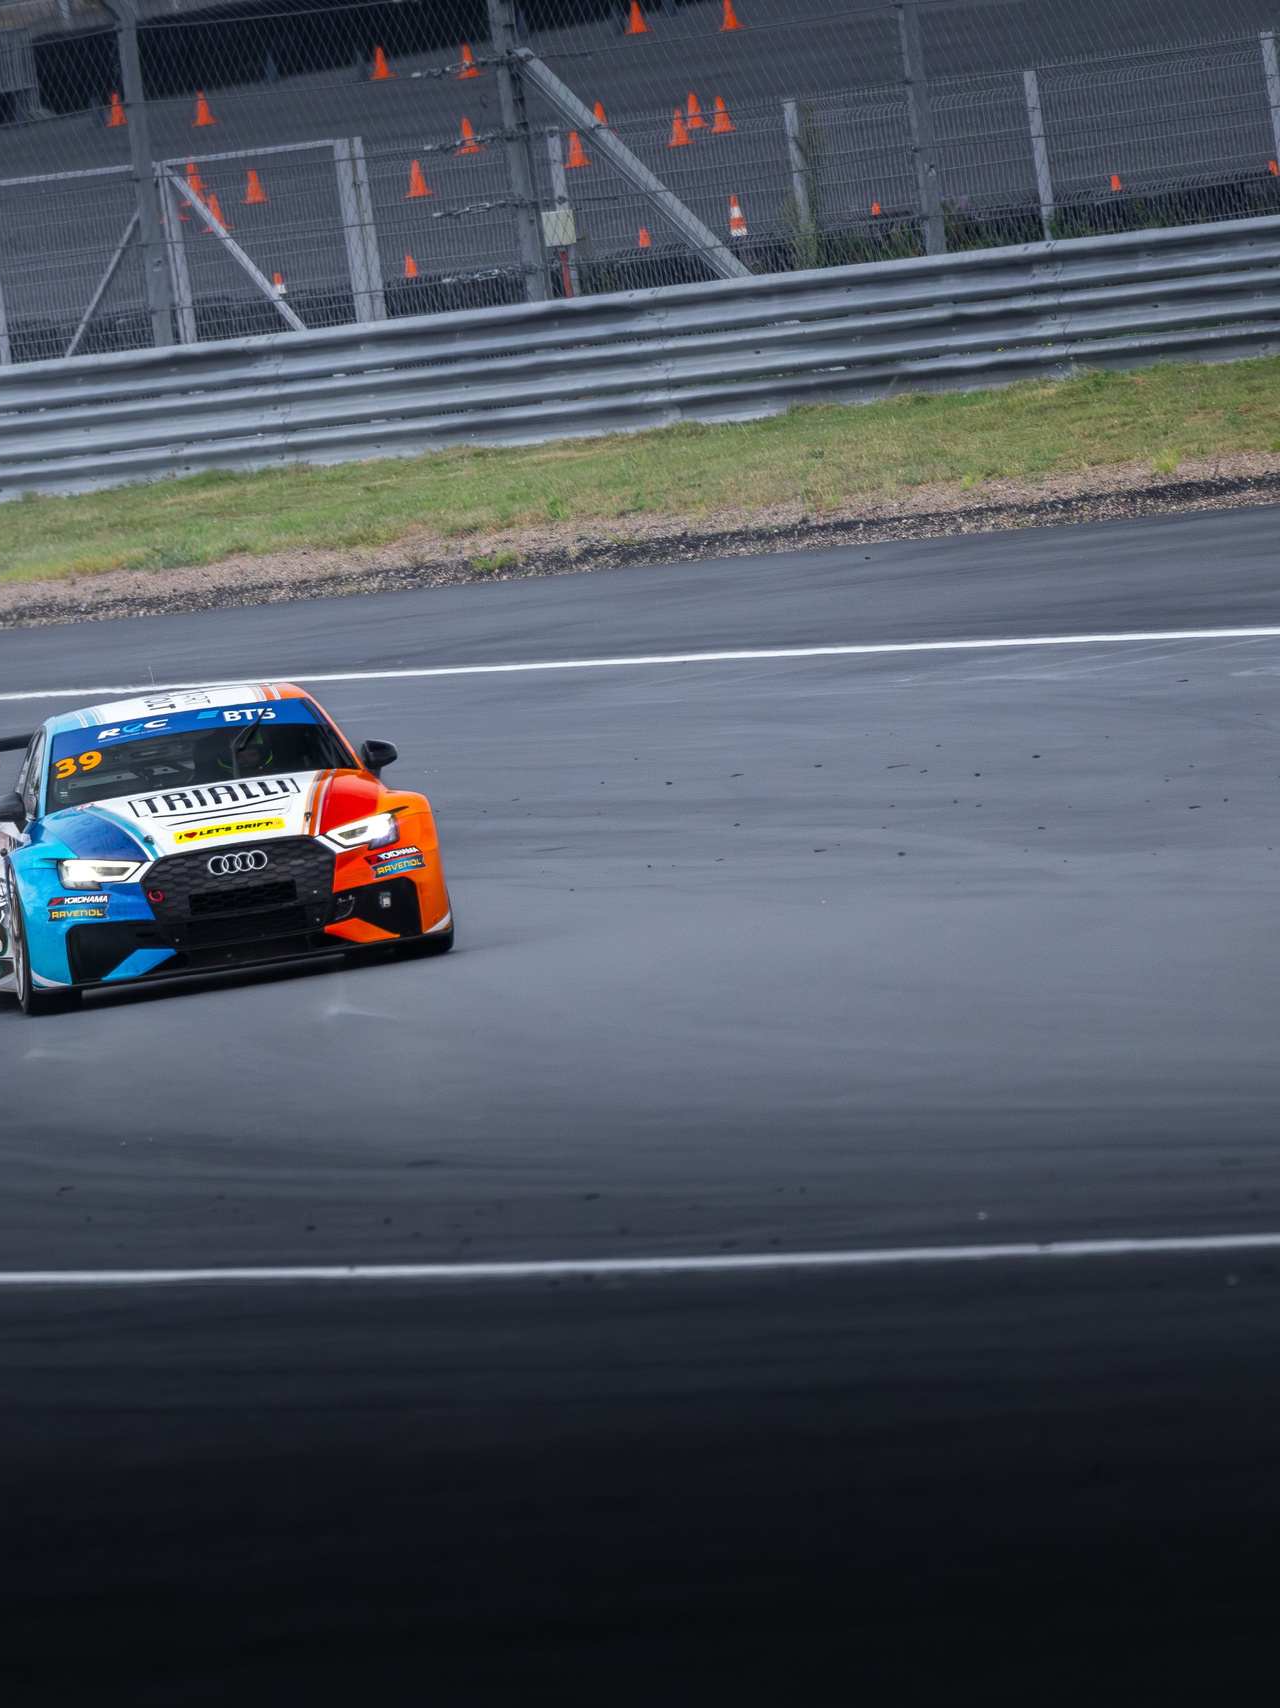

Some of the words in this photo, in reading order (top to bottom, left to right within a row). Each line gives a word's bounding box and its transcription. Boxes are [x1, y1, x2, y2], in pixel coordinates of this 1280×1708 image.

[55, 750, 102, 779] 39
[138, 780, 291, 814] TRIALLI
[199, 826, 232, 836] LET'S
[235, 821, 273, 830] DRIFT
[377, 846, 420, 860] YOKOHAMA
[376, 859, 422, 875] RAVENOL
[64, 895, 108, 904] YOKOHAMA
[51, 908, 104, 919] RAVENOL
